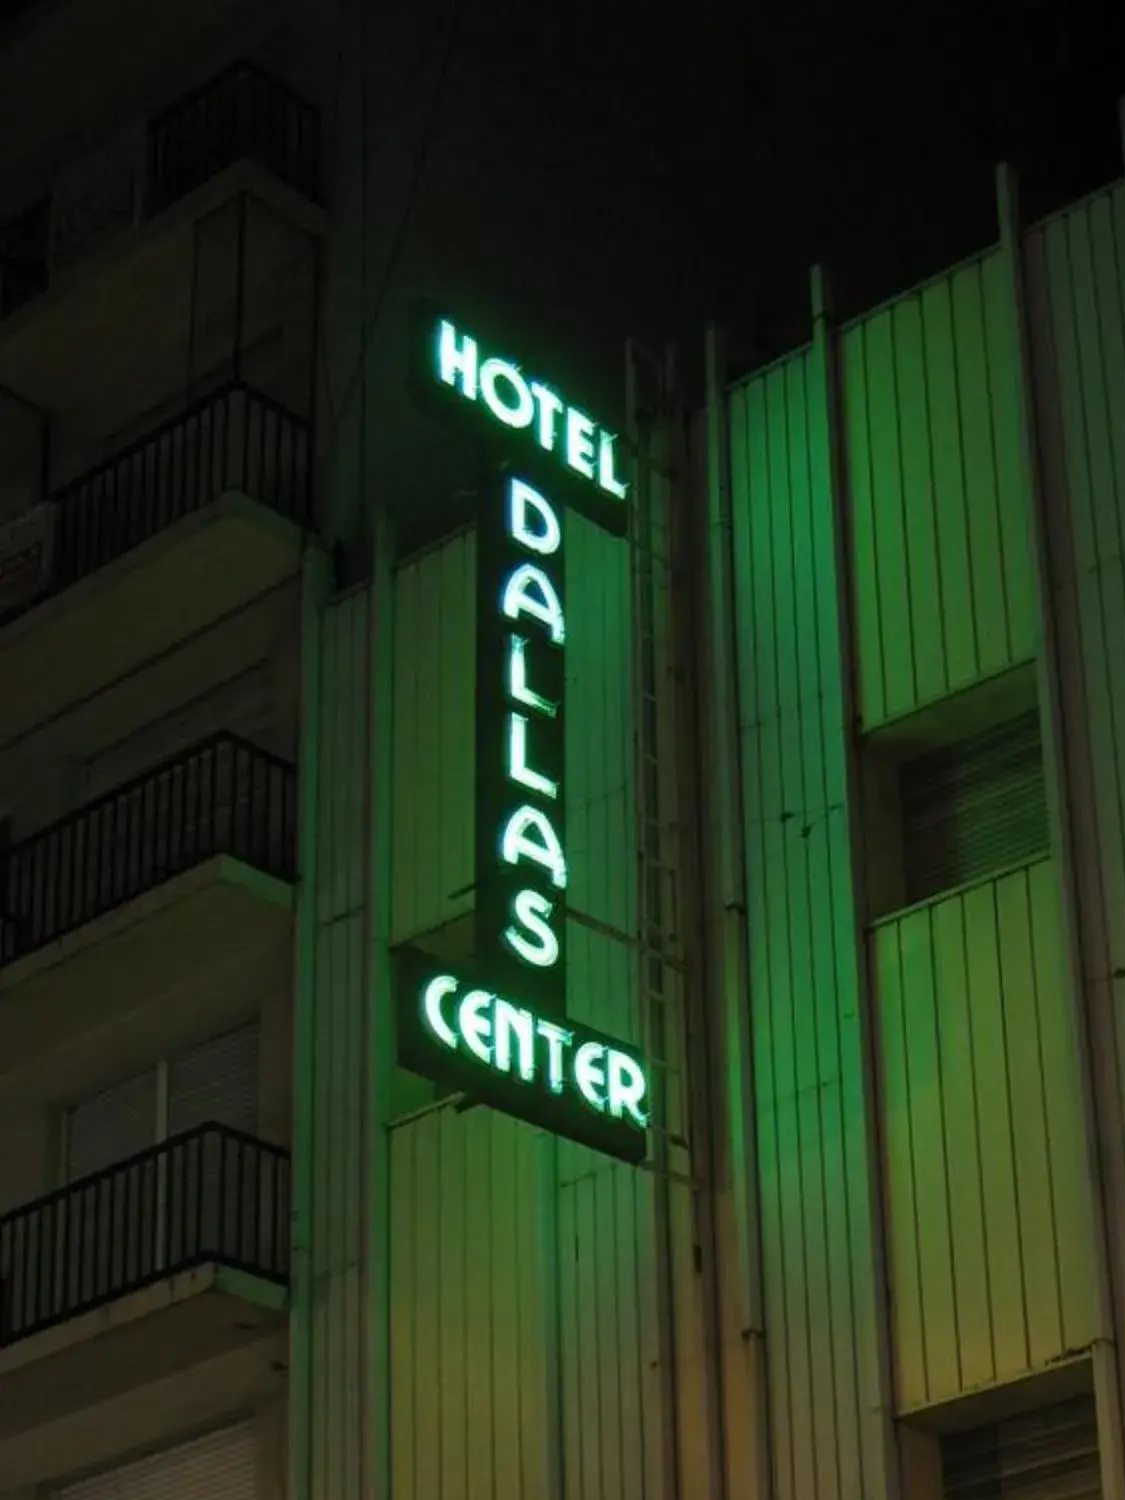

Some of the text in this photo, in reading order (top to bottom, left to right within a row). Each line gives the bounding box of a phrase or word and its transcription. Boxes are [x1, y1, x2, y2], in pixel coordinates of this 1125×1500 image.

[438, 318, 627, 500] HOTEL
[503, 477, 566, 968] DALLAS
[424, 974, 650, 1128] CENTER
